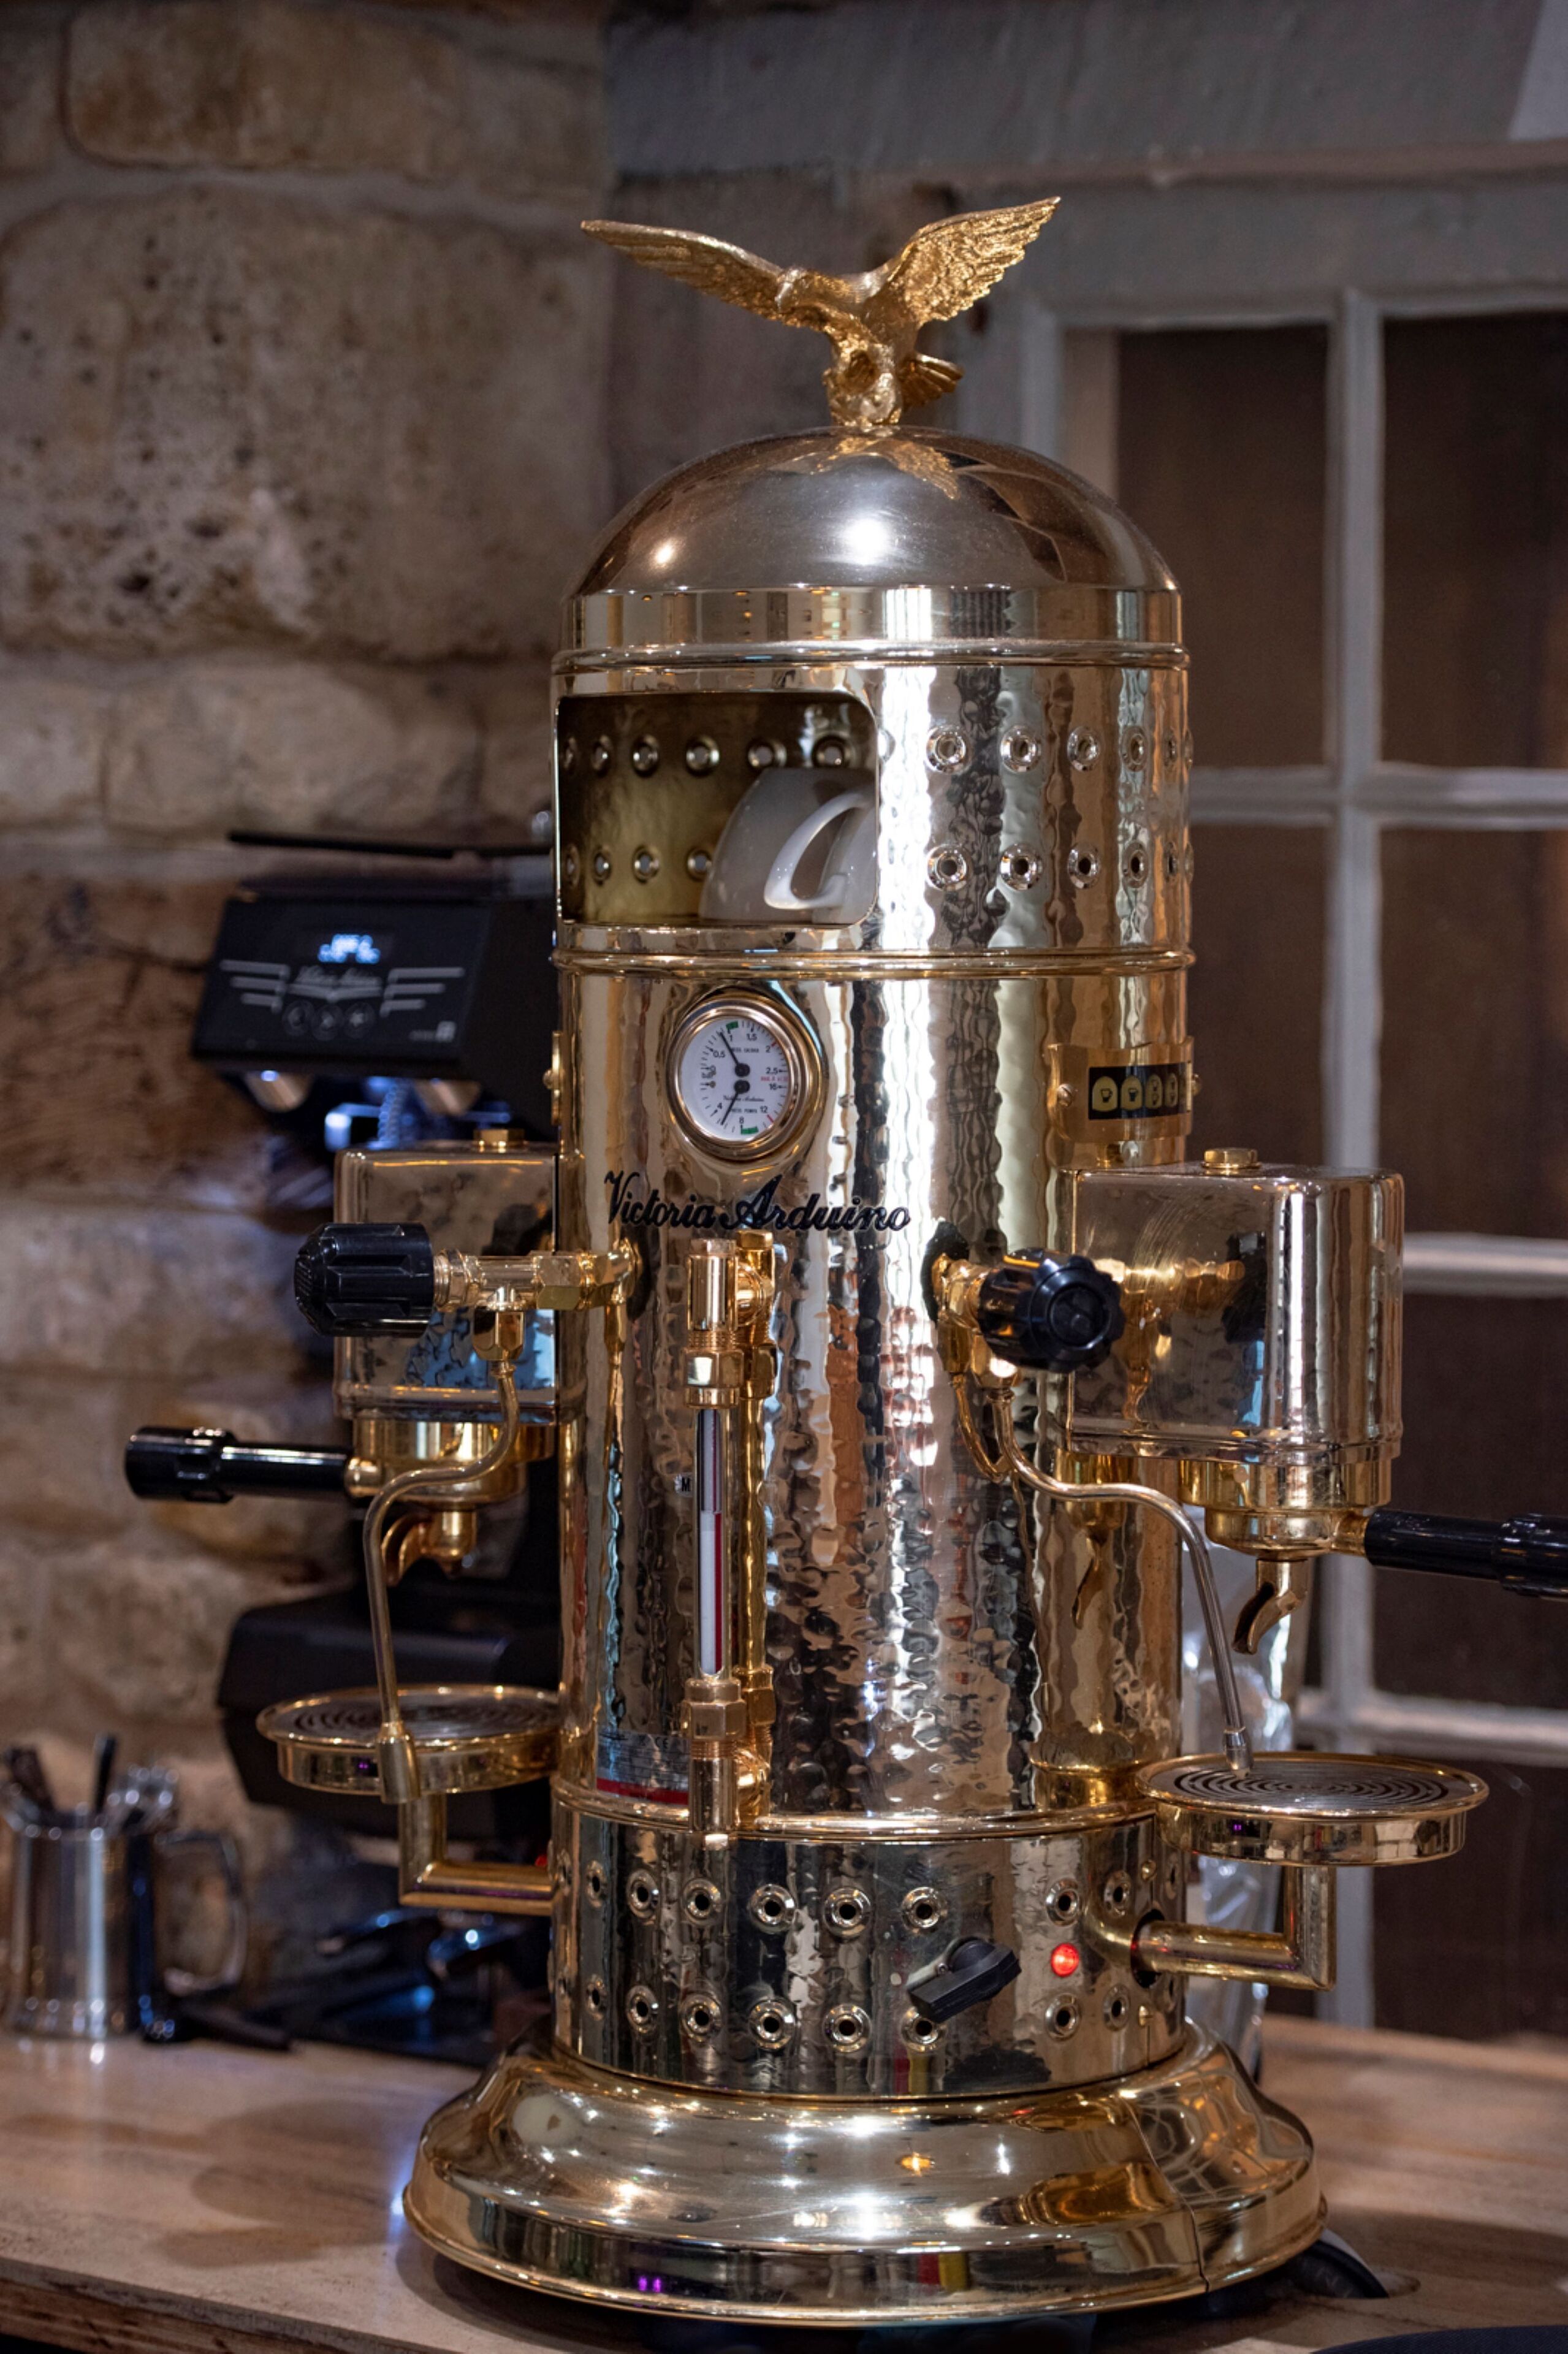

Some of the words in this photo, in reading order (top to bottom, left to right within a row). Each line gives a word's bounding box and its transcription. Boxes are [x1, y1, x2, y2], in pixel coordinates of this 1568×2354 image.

[713, 1049, 726, 1058] 0,5
[603, 1170, 717, 1227] Victoria
[718, 1173, 911, 1231] Arduino
